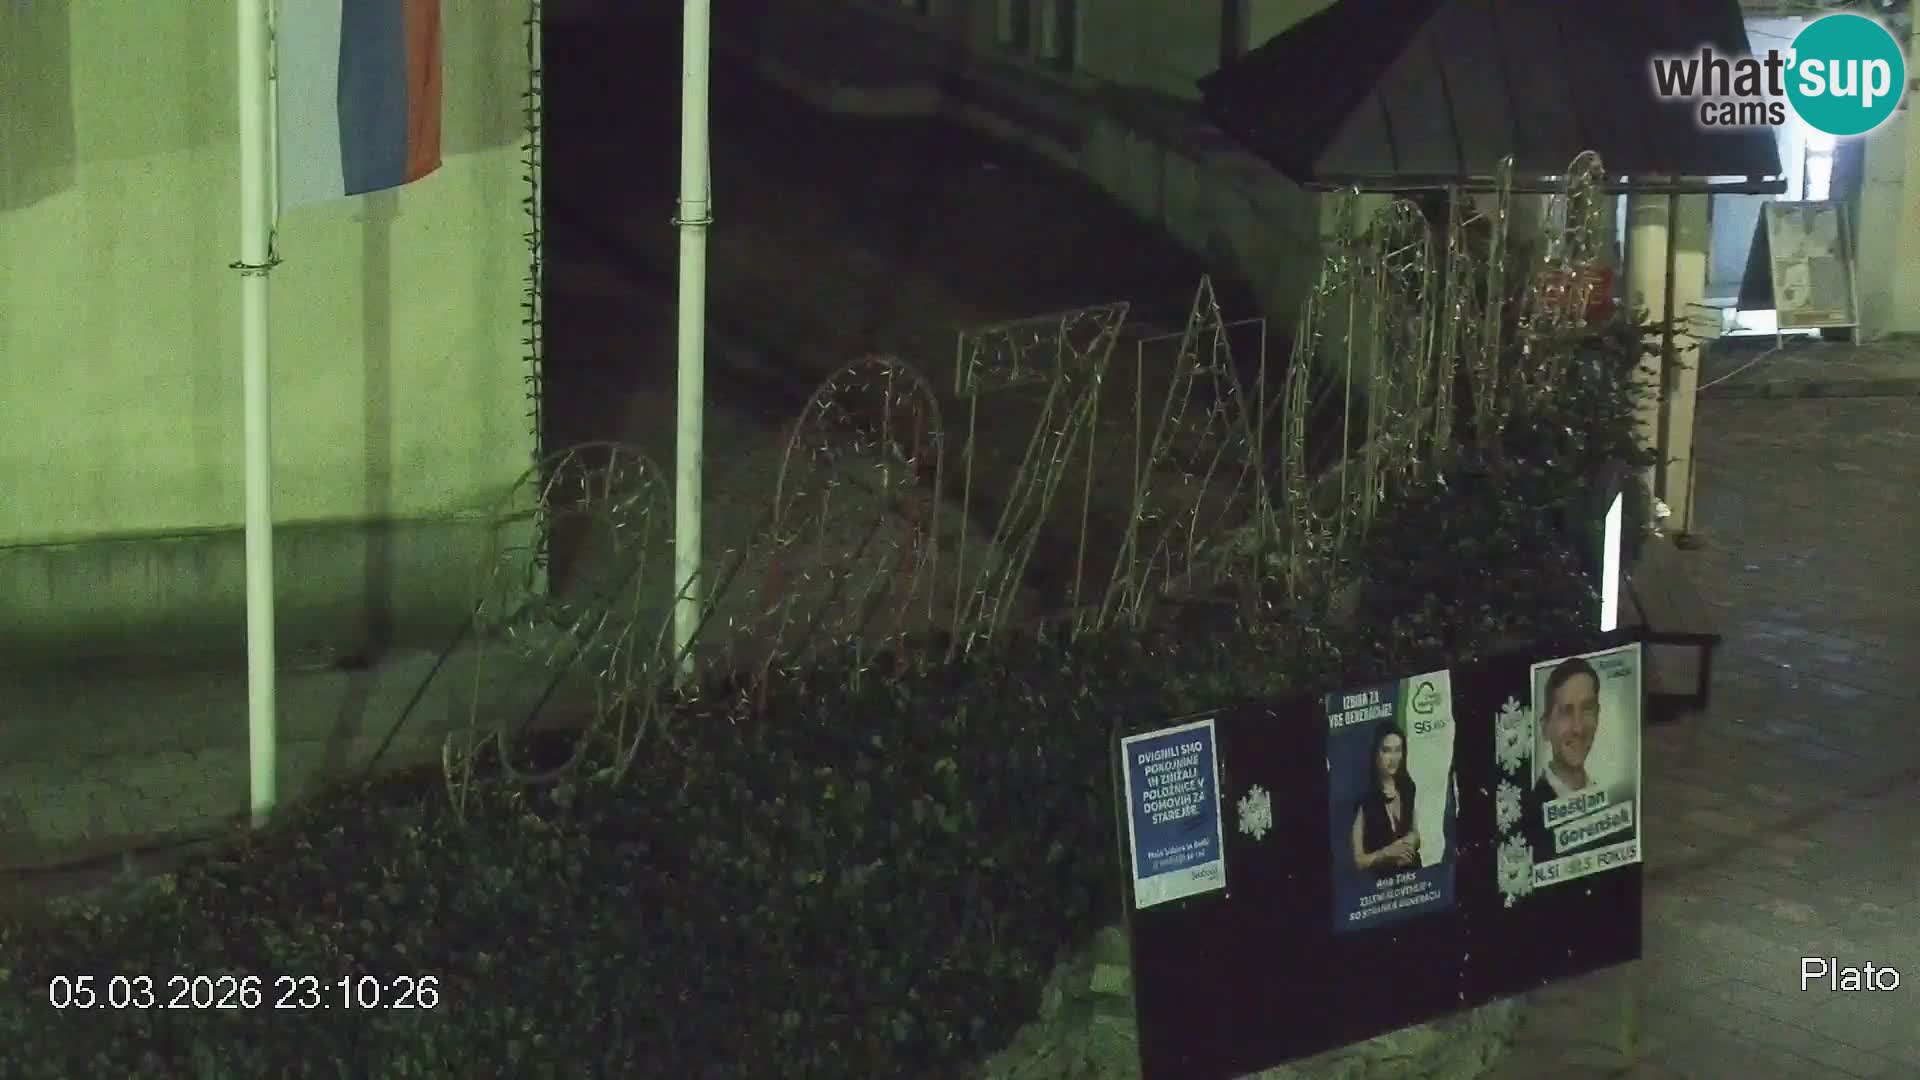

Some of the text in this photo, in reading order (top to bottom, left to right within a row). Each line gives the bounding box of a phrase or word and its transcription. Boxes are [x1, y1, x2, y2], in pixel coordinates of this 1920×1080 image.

[1138, 741, 1203, 765] DVIGNILI SMO
[1198, 777, 1205, 788] V
[1143, 793, 1192, 814] DOMOVIH
